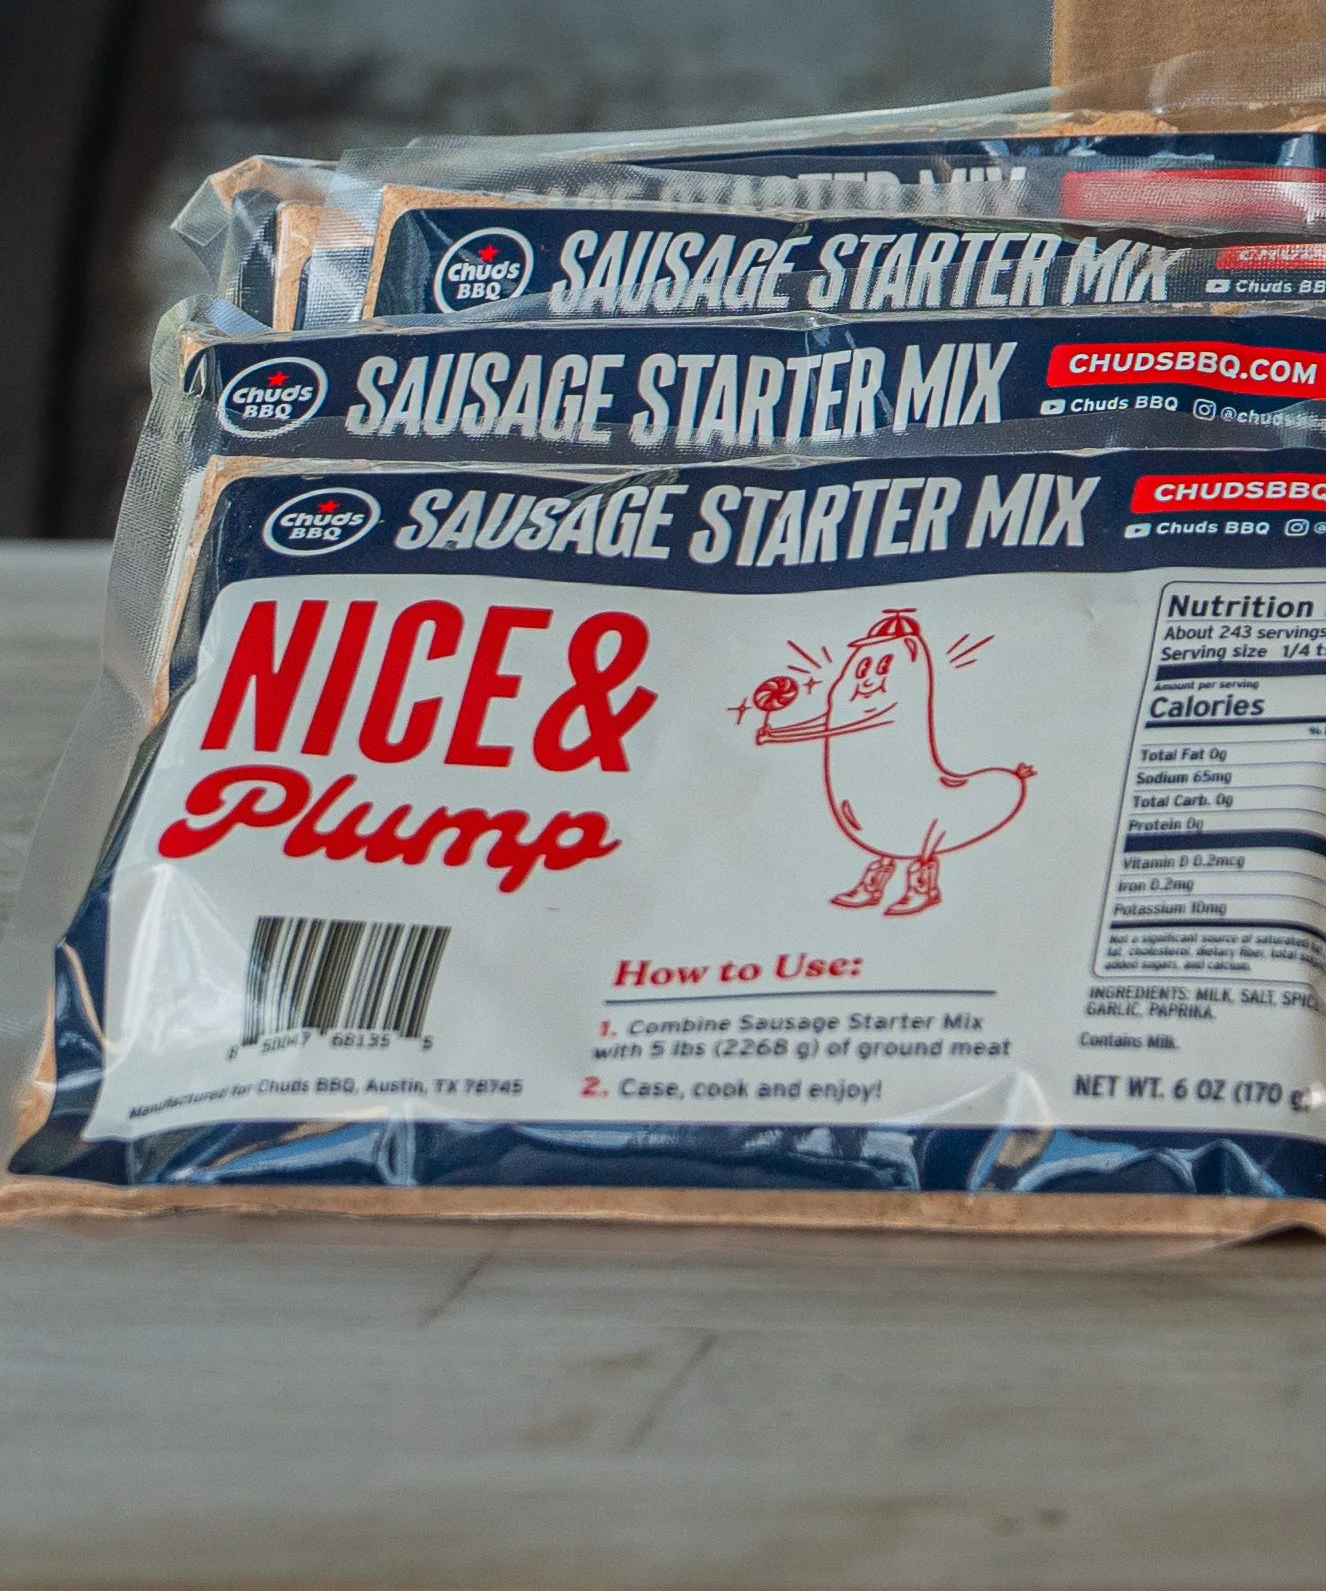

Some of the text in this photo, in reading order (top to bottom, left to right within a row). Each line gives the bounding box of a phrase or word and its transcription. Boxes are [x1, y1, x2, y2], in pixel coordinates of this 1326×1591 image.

[448, 262, 522, 281] Chuds
[548, 229, 1191, 312] SAUSAGE STARTER MIX
[456, 282, 501, 300] BBQ
[1235, 279, 1292, 293] Chuds
[1068, 352, 1318, 385] CHUDSBBQ.COM
[233, 386, 314, 404] Chuds
[345, 342, 1019, 447] SAUSAGE STARTER MIX
[243, 405, 292, 420] BBQ
[1070, 396, 1178, 412] Chuds BBQ
[280, 512, 365, 527] Chuds
[395, 474, 1101, 566] SAUSAGE STARTER MIX
[1156, 522, 1218, 536] Chuds
[1224, 521, 1270, 535] BBQ
[289, 527, 342, 541] BBQ
[1168, 595, 1314, 618] Nutrition
[1165, 626, 1214, 640] About
[1218, 625, 1251, 639] 243
[1161, 646, 1225, 661] Serving
[1232, 645, 1267, 658] size
[1283, 643, 1309, 658] 1/4
[1150, 694, 1264, 718] Calories
[1141, 748, 1204, 761] Total Fat
[1136, 771, 1188, 784] Sodium
[1133, 794, 1169, 808] Total
[158, 764, 622, 892] Plump
[1127, 819, 1181, 831] Protein
[613, 952, 863, 987] How to Use:
[627, 1012, 984, 1036] Combine Sausage Starter Mix
[592, 1044, 643, 1059] with
[650, 1040, 665, 1057] 5
[673, 1040, 706, 1057] lbs
[826, 1037, 851, 1056] of
[857, 1039, 943, 1060] ground
[952, 1038, 1011, 1056] meat
[433, 1079, 458, 1093] TX
[619, 1077, 882, 1103] Case, cook and enjoy!
[1075, 1074, 1120, 1097] NET
[1127, 1076, 1164, 1099] WT.
[1173, 1078, 1188, 1100] 6
[1196, 1079, 1226, 1100] OZ
